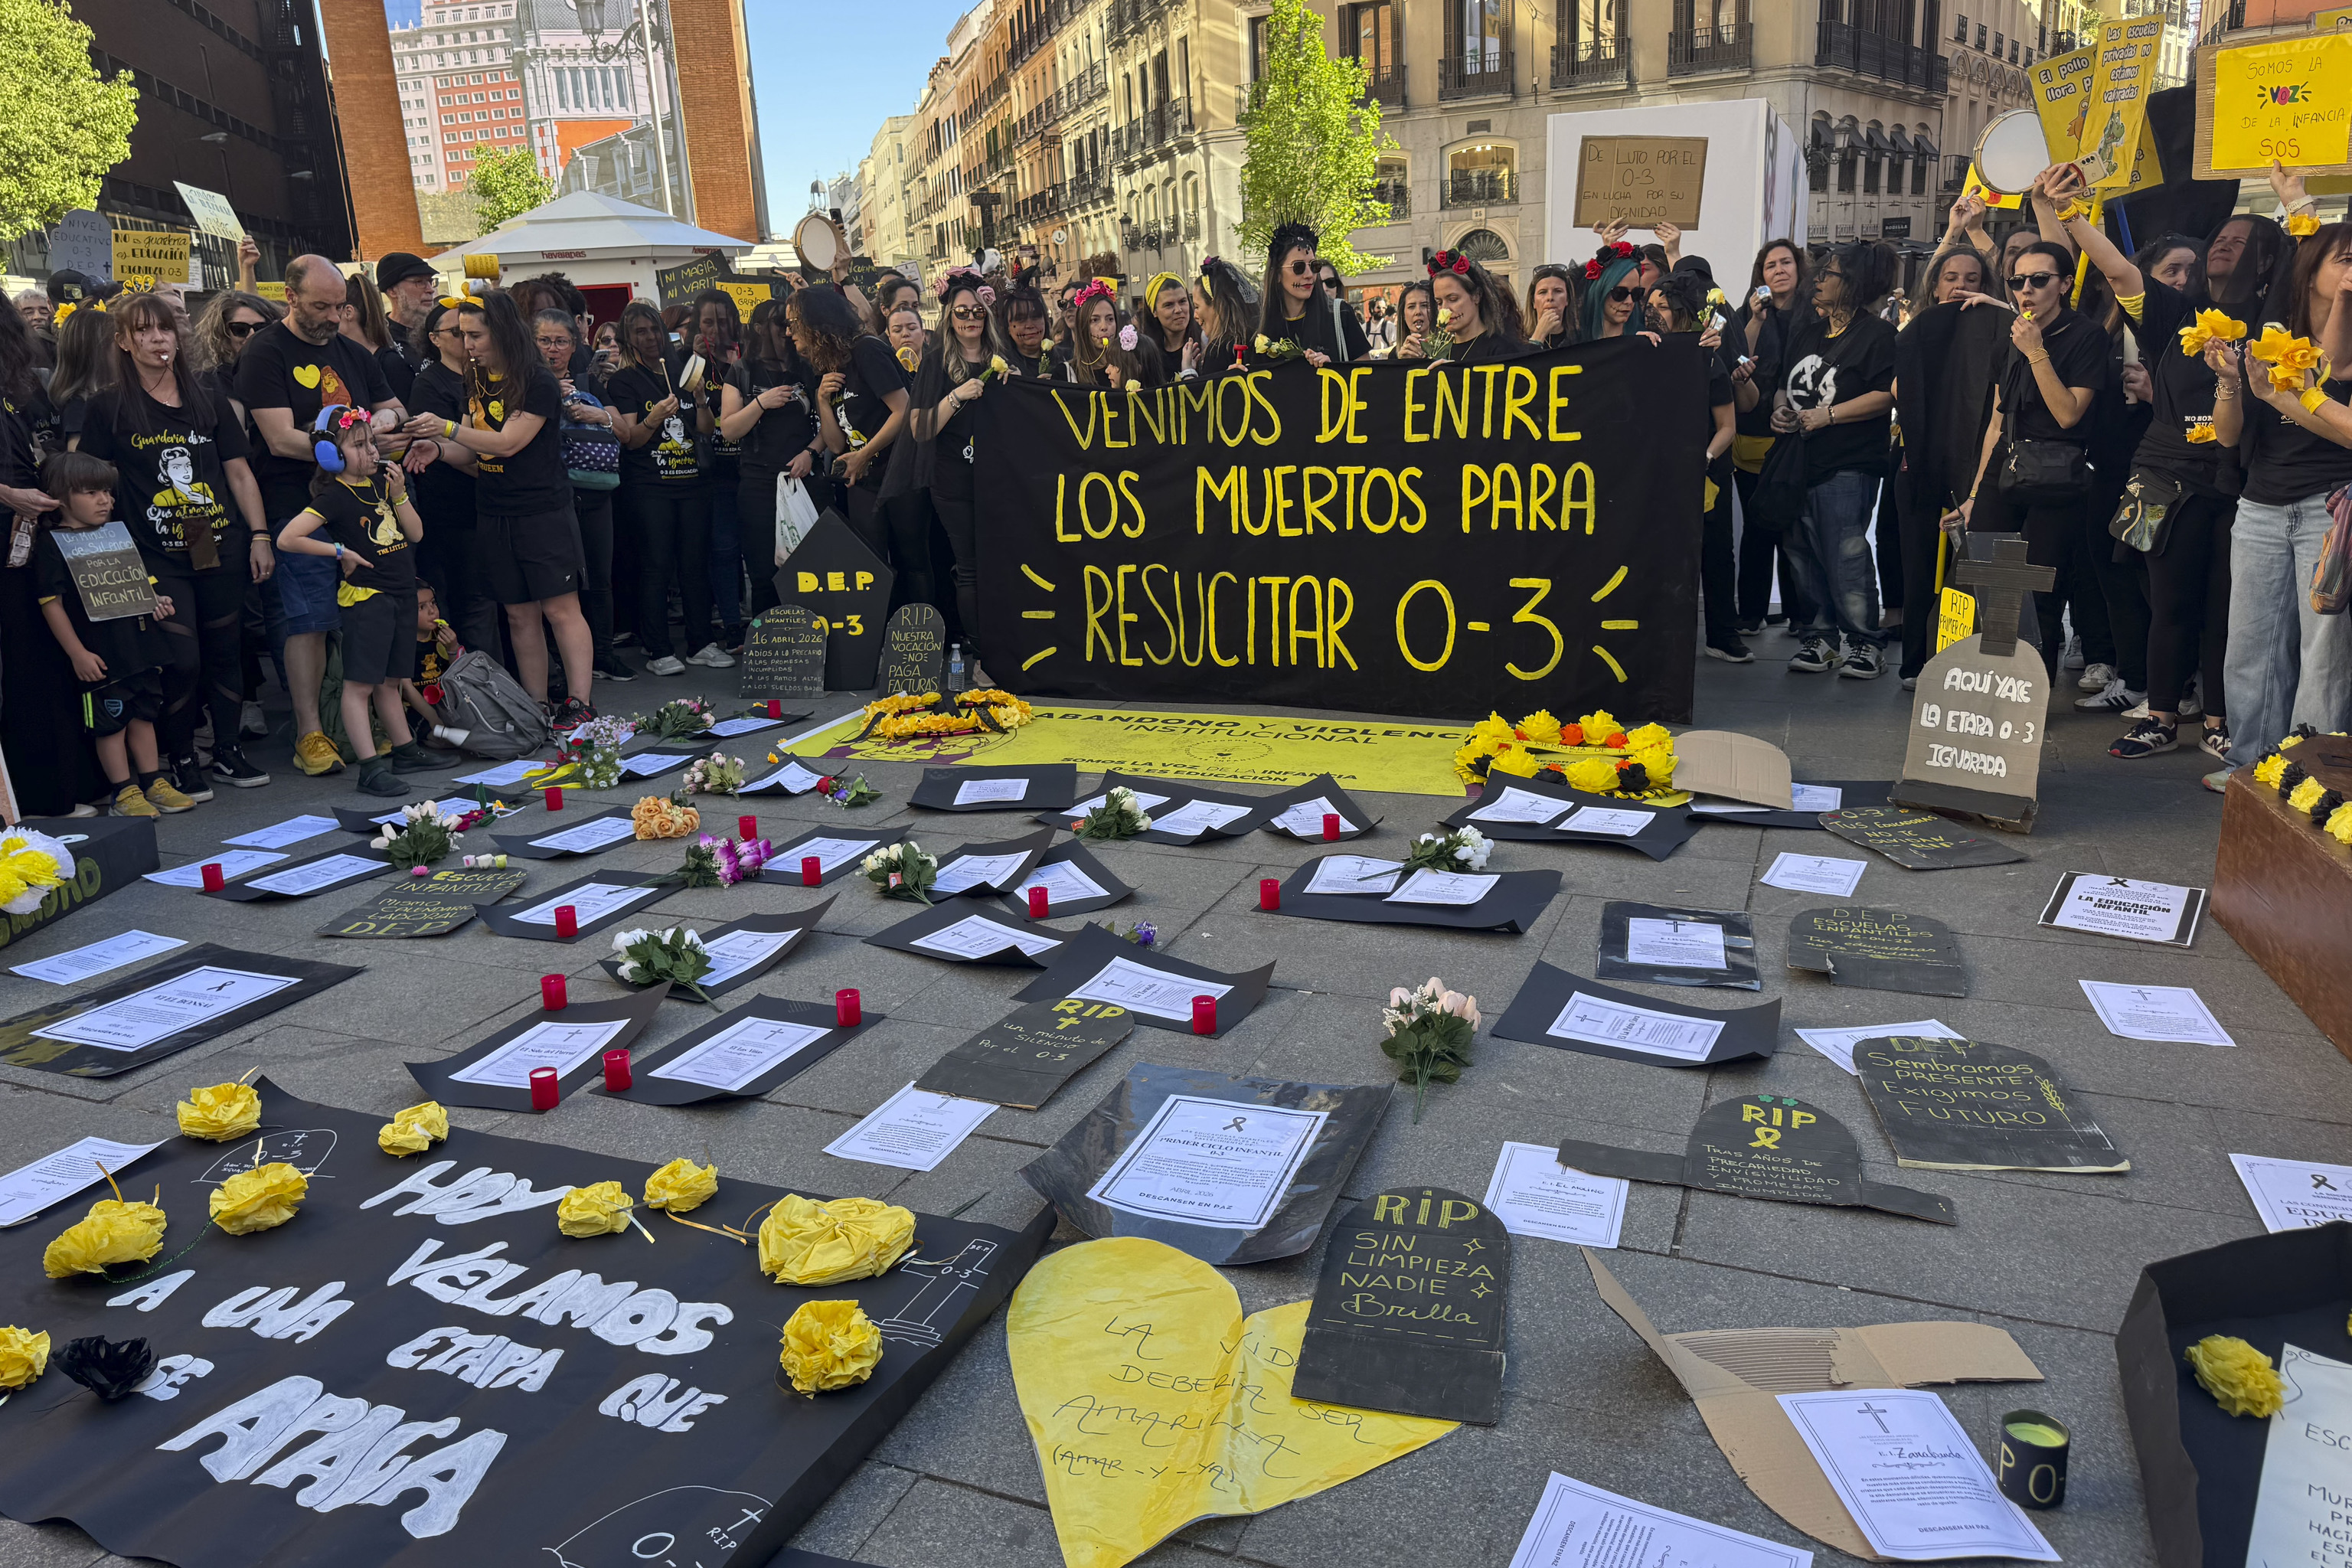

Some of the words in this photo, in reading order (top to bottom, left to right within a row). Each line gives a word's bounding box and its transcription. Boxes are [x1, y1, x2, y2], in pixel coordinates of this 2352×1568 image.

[2106, 27, 2122, 42] Las
[2126, 21, 2159, 38] escuelas
[2102, 44, 2137, 67] privadas
[2141, 44, 2152, 57] no
[2308, 56, 2322, 72] LA
[2039, 69, 2053, 85] El
[2058, 57, 2089, 80] pollo
[2110, 65, 2140, 82] estamos
[2046, 82, 2076, 103] llora
[2103, 84, 2139, 103] valoradas
[2269, 85, 2300, 106] VOZ
[2240, 116, 2258, 129] DE
[2269, 117, 2281, 128] LA
[1588, 144, 1604, 162] DE
[1615, 147, 1648, 165] LUTO
[1656, 149, 1678, 165] POR
[1683, 151, 1697, 165] EL
[2259, 138, 2300, 158] SOS
[1622, 168, 1655, 187] 0-3
[1583, 191, 1599, 200] EN
[1602, 191, 1632, 201] LUCHA
[1646, 189, 1664, 200] POR
[1670, 191, 1684, 200] SU
[1609, 205, 1668, 220] DIGNIDAD
[68, 220, 103, 231] NIVEL
[115, 234, 130, 243] NO
[73, 247, 92, 256] 0-3
[541, 250, 586, 259] havaianas
[736, 286, 754, 296] 0-3
[1050, 368, 1282, 452] VENIMOS
[1315, 365, 1375, 446] DE
[1403, 362, 1584, 444] ENTRE
[1054, 469, 1146, 544] LOS
[1195, 464, 1429, 537] MUERTOS
[1461, 460, 1597, 536] PARA
[1951, 592, 1968, 613] RIP
[1084, 563, 1360, 672] RESUCITAR
[1395, 577, 1564, 682] 0-3
[1939, 613, 1958, 636] PRIMER
[751, 632, 768, 645] 16
[771, 635, 795, 644] ABRIL
[798, 633, 823, 645] 2026
[891, 630, 934, 642] NUESTRA
[891, 641, 942, 652] VOCACIÓN
[907, 653, 923, 663] NO
[888, 665, 921, 678] PAGA
[887, 677, 938, 694] FACTURAS
[1944, 668, 1994, 694] AQUÍ
[1995, 674, 2032, 703] YACE
[1034, 711, 1241, 729] ABANDONO
[1258, 722, 1278, 730] Y
[1946, 710, 1993, 738] ETAPA
[1123, 724, 1378, 746] INSTITUCIONAL
[1060, 756, 1126, 766] SOMOS
[1129, 759, 1153, 767] LA
[1156, 761, 1198, 769] VOZ
[1261, 769, 1358, 780] INFANCIA
[1926, 743, 2007, 778] IGNORADA
[1112, 766, 1138, 774] 0-3
[1145, 769, 1170, 777] ES
[1172, 771, 1288, 782] EDUCACIÓN
[1841, 809, 1884, 818] 0-3
[1829, 821, 1868, 830] TUS
[395, 881, 518, 893] INFANTILES
[2092, 902, 2151, 916] INFANTIL
[2097, 898, 2171, 913] EDUCACIÓN
[1813, 917, 1911, 932] ESCUELAS
[1814, 924, 1934, 938] INFANTILES
[1051, 999, 1126, 1019] RIP
[1003, 1022, 1024, 1033] un
[1035, 1029, 1086, 1044] minuto
[1089, 1036, 1106, 1046] de
[1014, 1034, 1080, 1050] SILENCIO
[978, 1039, 998, 1049] Por
[1003, 1046, 1018, 1054] el
[1035, 1050, 1070, 1062] 0-3
[1867, 1051, 2034, 1074] Sembramos
[1882, 1080, 2031, 1104] Exigimos
[1742, 1103, 1817, 1129] RIP
[1898, 1100, 2047, 1125] FUTURO
[1160, 1137, 1199, 1148] PRIMER
[1200, 1142, 1234, 1152] CICLO
[1234, 1146, 1285, 1158] INFANTIL
[1702, 1144, 1743, 1158] TRAS
[1752, 1153, 1792, 1165] AÑOS
[358, 1159, 573, 1226] HOY
[1169, 1187, 1193, 1196] ABRIL
[1194, 1188, 1214, 1197] 2026
[1731, 1175, 1824, 1191] PROMESAS
[1138, 1192, 1195, 1205] DESCANSEN
[1354, 1232, 1416, 1252] SIN
[941, 1265, 972, 1279] 0-3
[1348, 1252, 1495, 1281] LIMPIEZA
[1341, 1272, 1447, 1295] NADIE
[386, 1236, 735, 1357] VELAMOS
[1341, 1292, 1479, 1325] Brilla
[1104, 1315, 1163, 1361] LA
[106, 1269, 197, 1312] A
[200, 1280, 355, 1344] UNA
[386, 1325, 566, 1393] ETAPA
[598, 1373, 730, 1433] QUE
[1297, 1402, 1376, 1445] SER
[154, 1374, 509, 1540] APAGA
[1918, 1524, 1963, 1534] DESCANSEN
